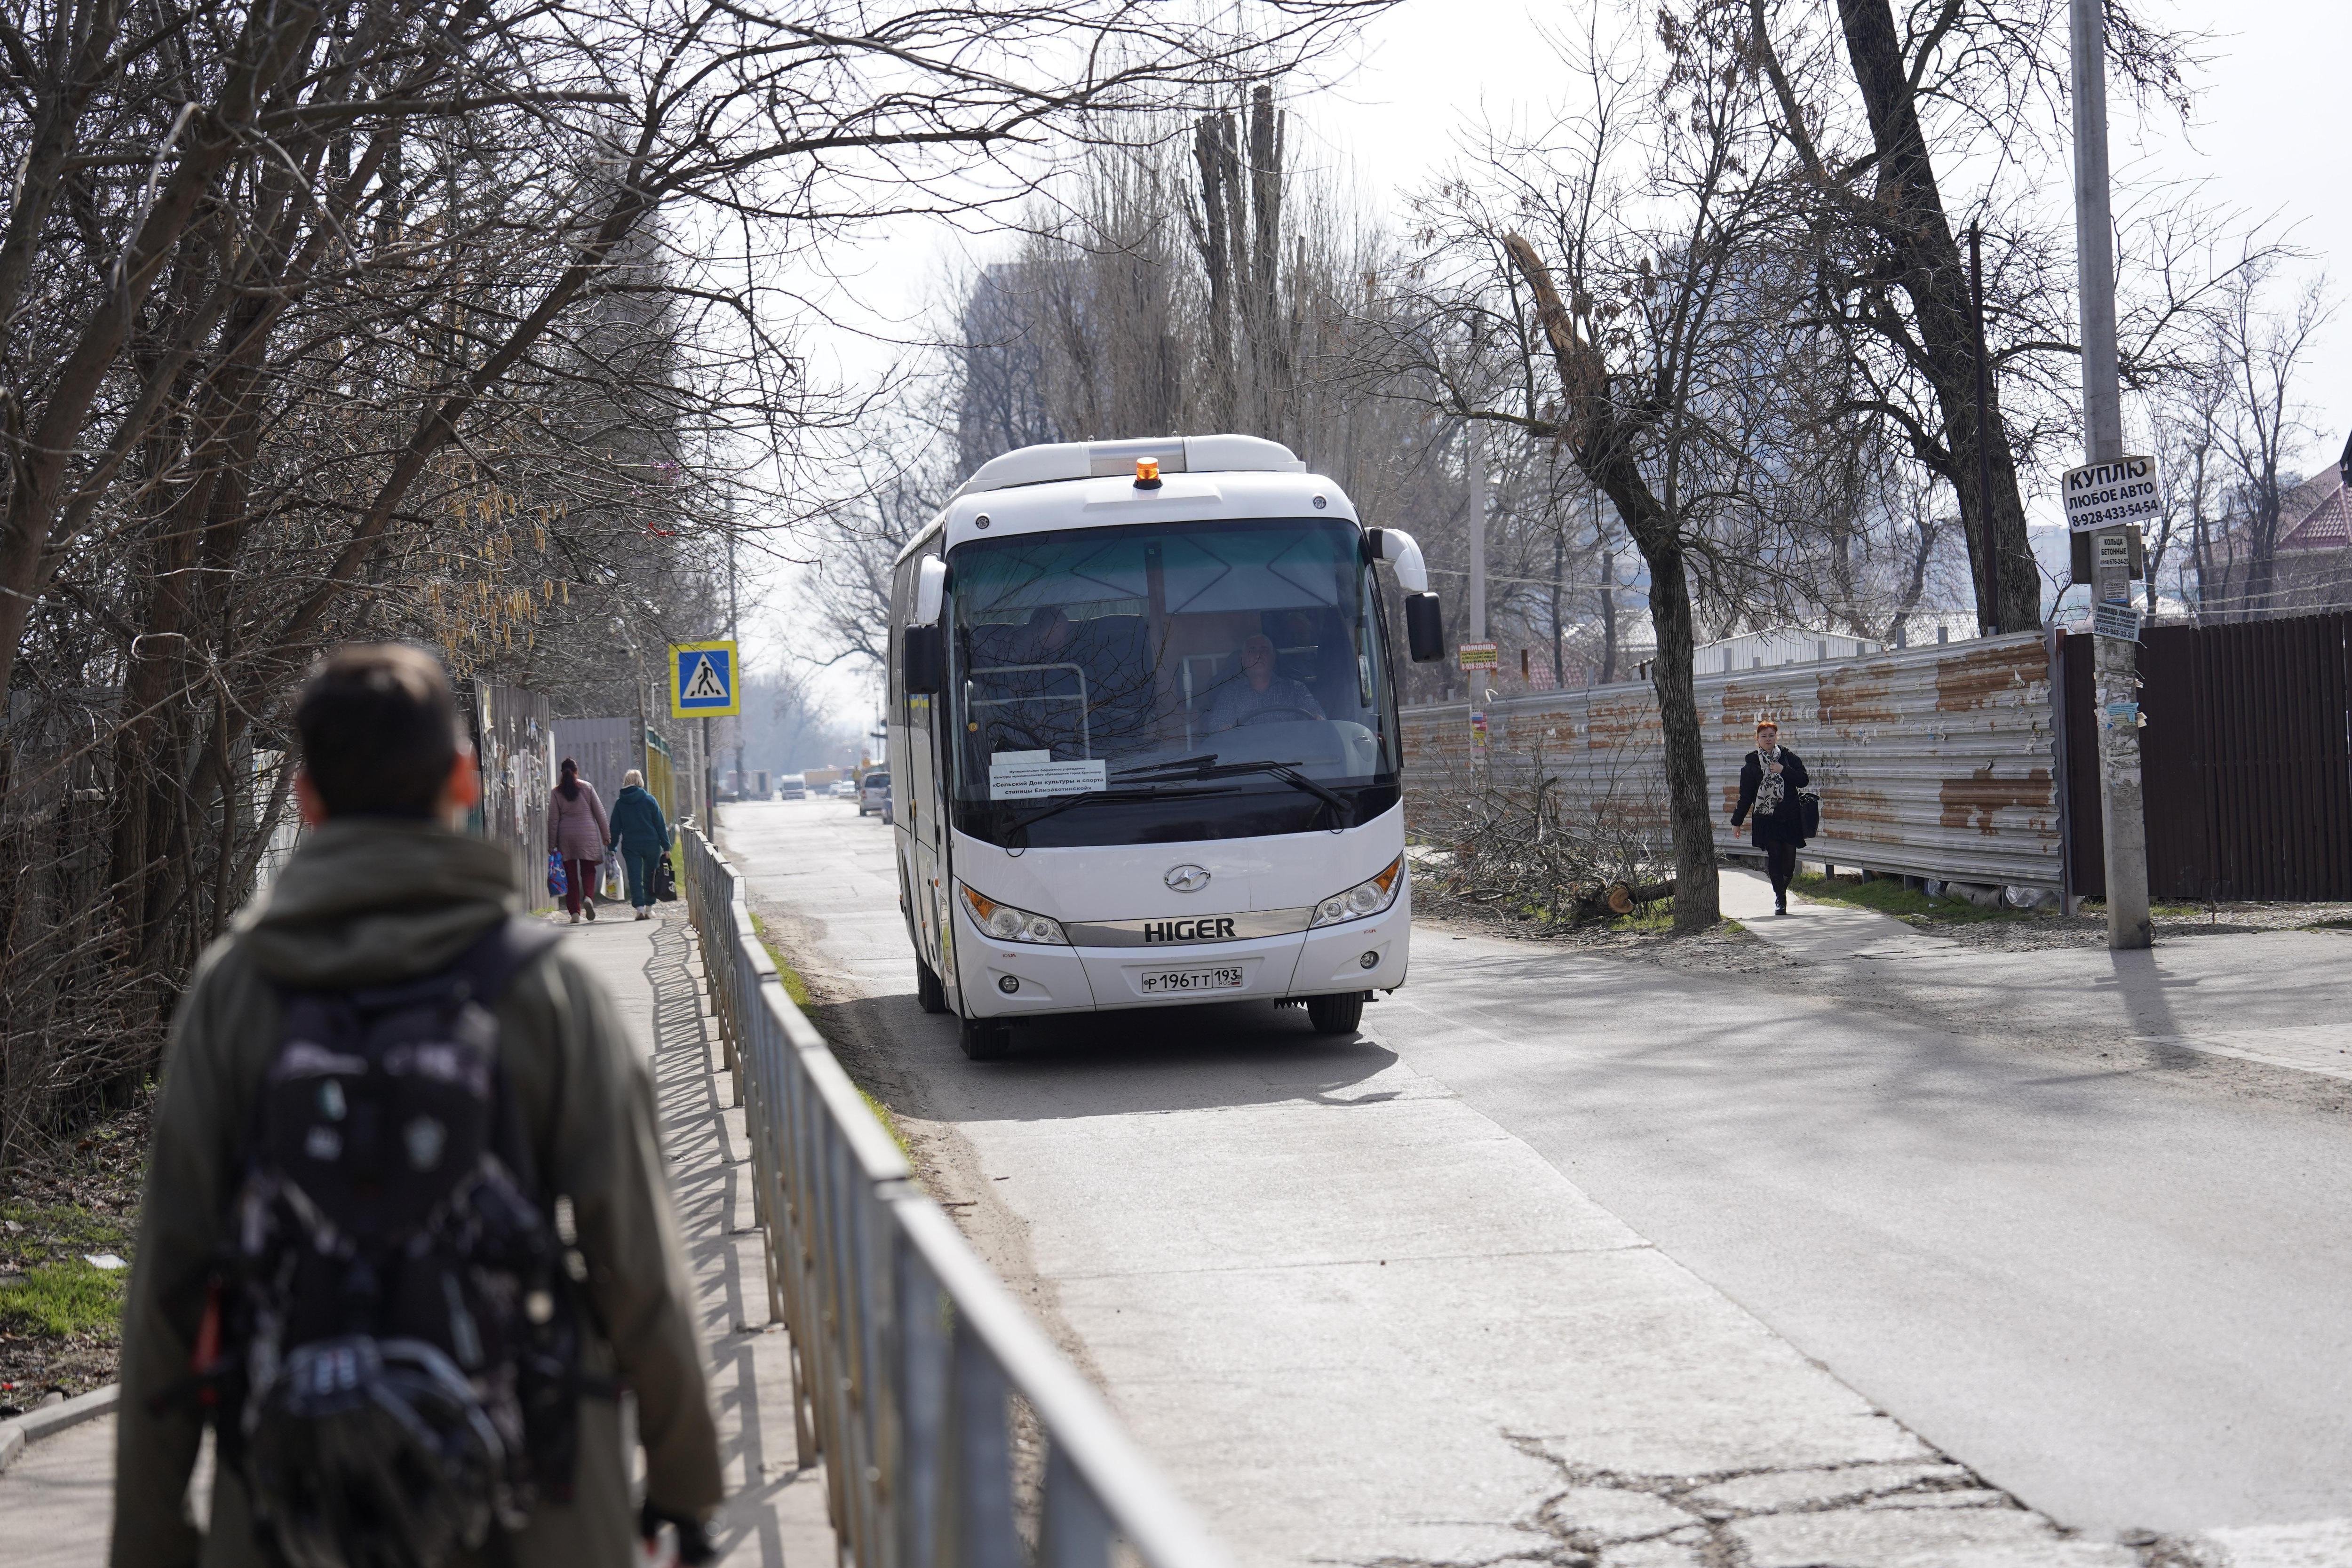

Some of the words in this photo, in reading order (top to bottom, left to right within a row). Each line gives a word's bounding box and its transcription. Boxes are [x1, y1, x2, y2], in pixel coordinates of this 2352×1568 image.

[2070, 461, 2147, 491] КУПЛЮ
[2069, 489, 2118, 510] ЛЮБОЕ
[2121, 482, 2153, 499] АВТО
[2098, 605, 2118, 616] ПОМОЩЬ
[2119, 610, 2137, 619] ЛЮДЯМ
[1144, 918, 1236, 942] HIGER
[1215, 970, 1237, 981] 193
